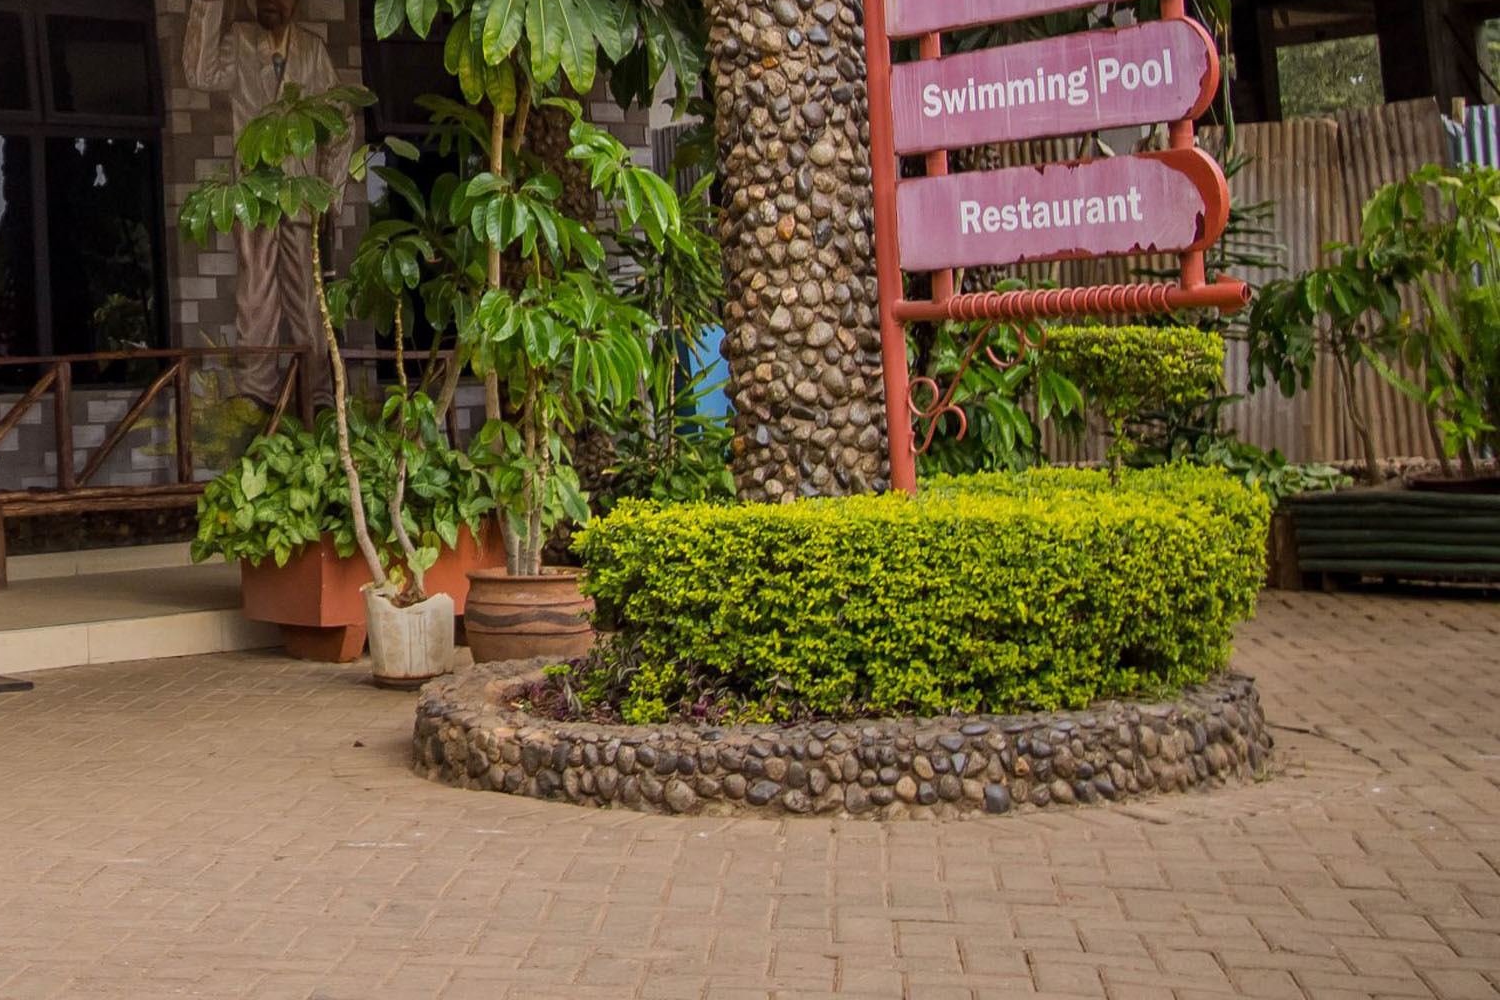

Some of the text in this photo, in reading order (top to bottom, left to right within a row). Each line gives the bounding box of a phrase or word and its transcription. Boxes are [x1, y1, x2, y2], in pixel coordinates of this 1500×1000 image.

[922, 48, 1173, 117] Swimming Pool
[959, 186, 1143, 235] Restaurant
